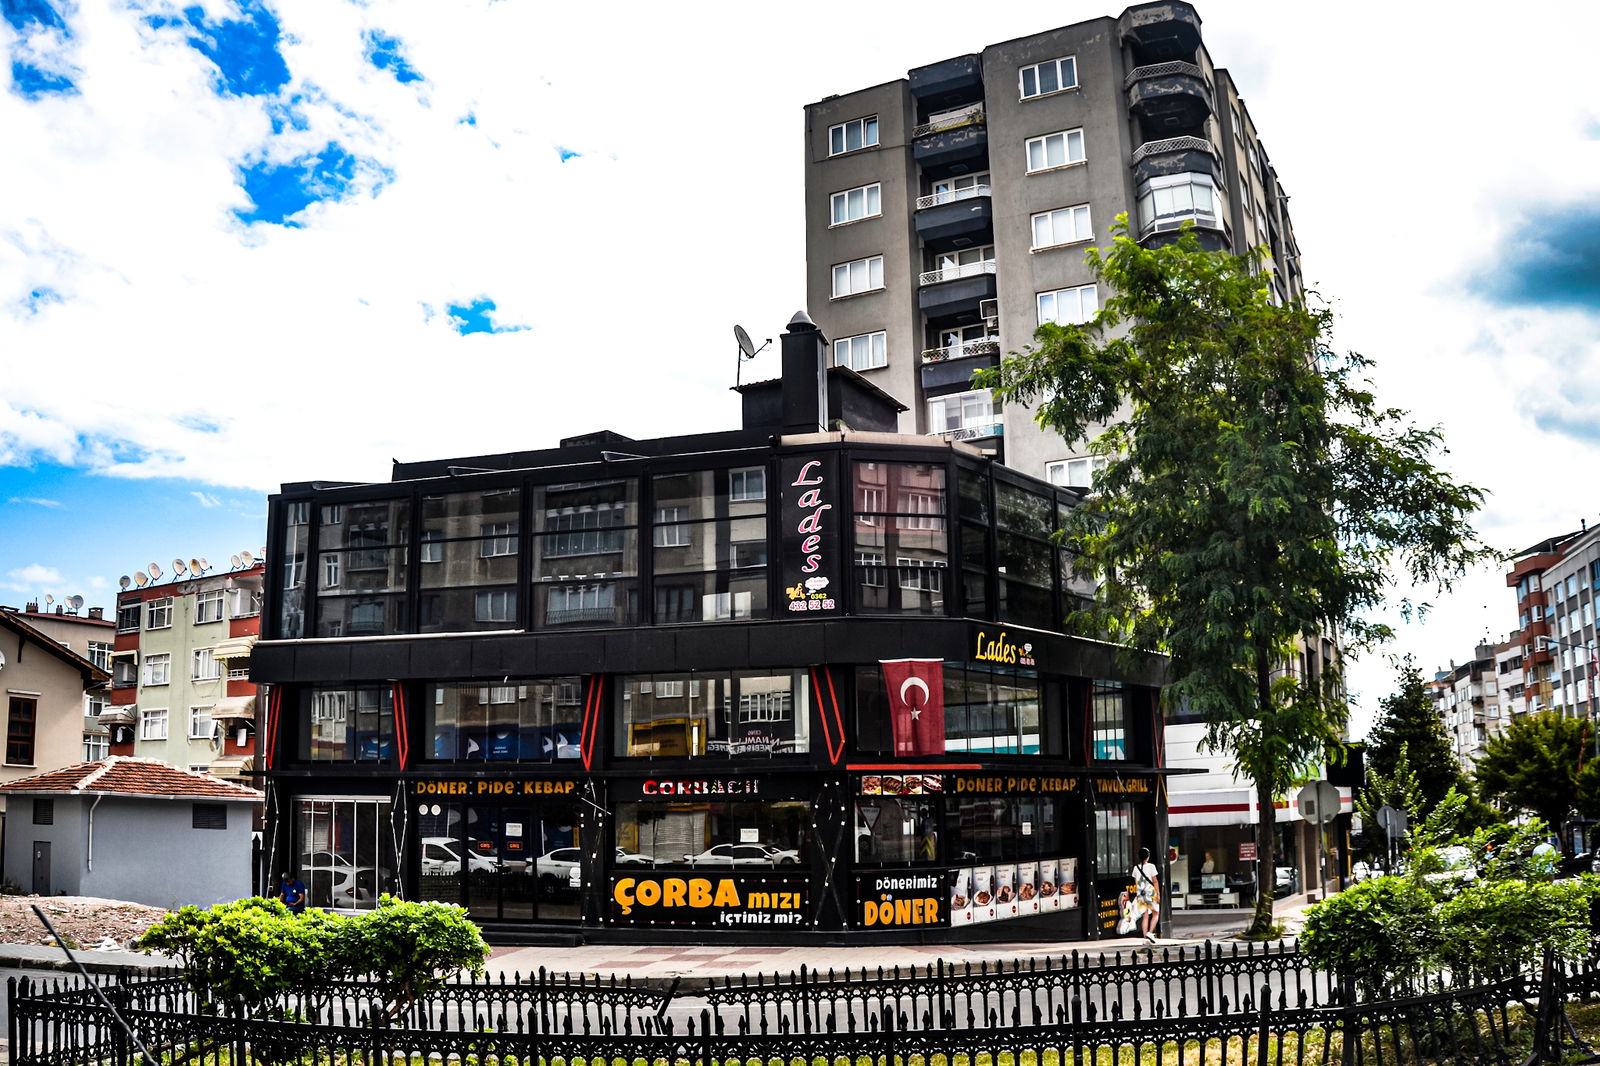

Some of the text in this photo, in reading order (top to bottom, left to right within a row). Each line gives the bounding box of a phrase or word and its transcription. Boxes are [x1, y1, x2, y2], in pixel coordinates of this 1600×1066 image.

[791, 460, 832, 573] Lades
[789, 598, 835, 611] 432 52 52
[975, 631, 1016, 664] Lades
[417, 780, 467, 795] DÖNER
[524, 781, 575, 795] KEBAP
[956, 776, 1003, 793] DÖNER
[1041, 777, 1077, 792] KEBAP
[1096, 778, 1149, 793] TAVUK GRILL
[614, 878, 741, 915] ÇORBA
[864, 893, 939, 926] DÖNER
